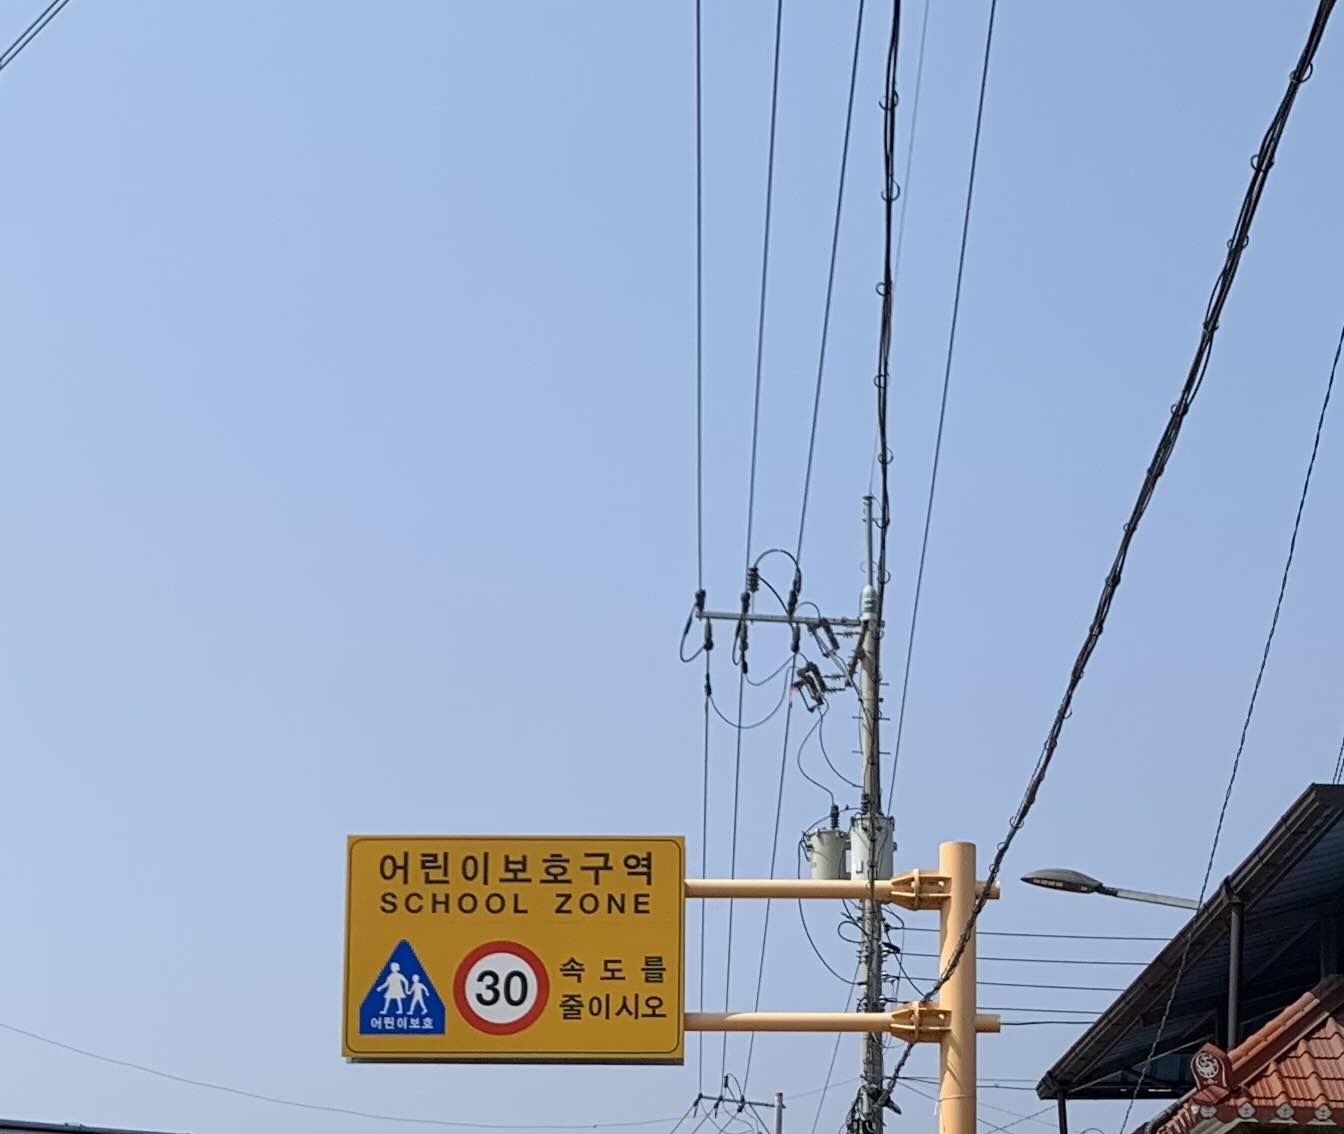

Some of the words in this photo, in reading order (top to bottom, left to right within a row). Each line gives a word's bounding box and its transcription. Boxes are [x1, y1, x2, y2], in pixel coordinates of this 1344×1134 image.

[379, 851, 653, 886] 어린이보호구역
[380, 892, 529, 914] SCHOOL
[555, 892, 651, 914] ZONE
[559, 956, 667, 984] 속도를
[476, 969, 529, 1007] 30
[559, 993, 667, 1020] 줄이시오
[370, 1017, 435, 1030] 어린이보호
